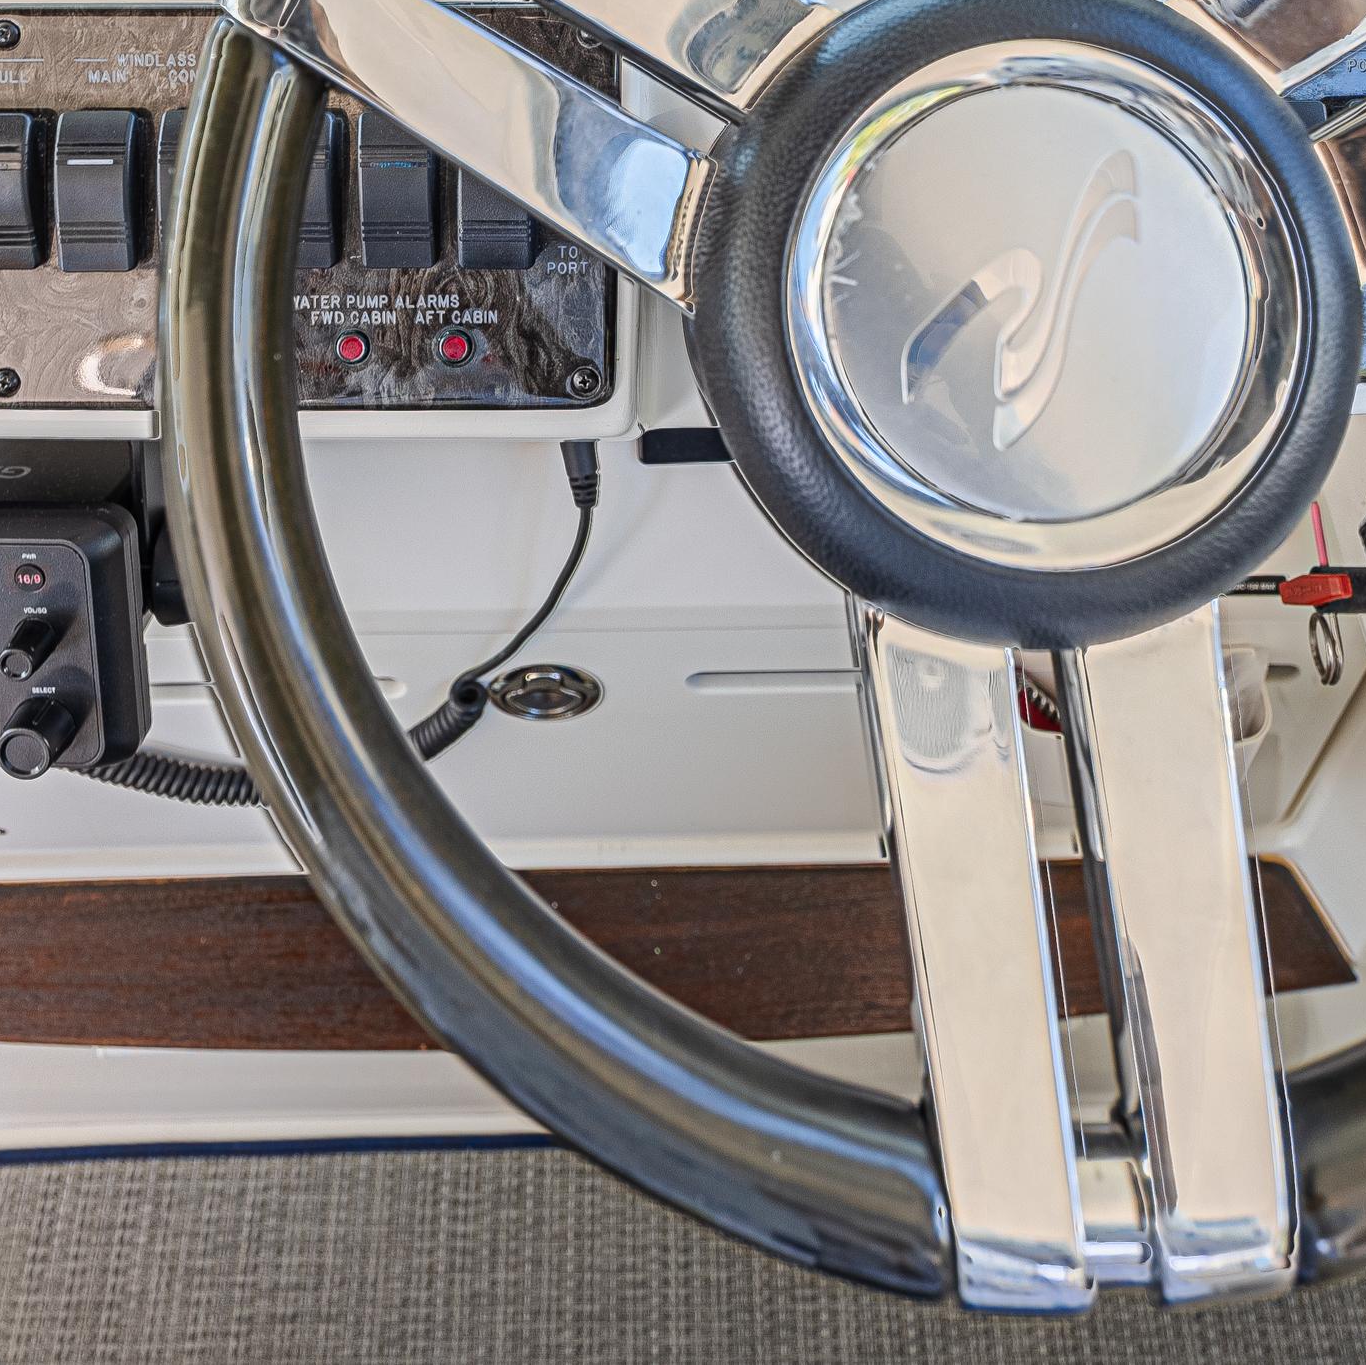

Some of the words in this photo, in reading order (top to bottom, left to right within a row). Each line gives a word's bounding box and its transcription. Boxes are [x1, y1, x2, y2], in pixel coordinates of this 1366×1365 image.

[117, 53, 197, 67] WINDLASS
[88, 70, 127, 84] MAIN
[557, 245, 578, 259] TO
[547, 262, 589, 275] PORT
[346, 295, 388, 309] PUMP
[395, 294, 460, 309] ALARMS
[311, 311, 345, 325] FWD
[350, 310, 396, 325] CABIN
[415, 310, 445, 324] AFT
[451, 310, 498, 324] CABIN
[18, 574, 41, 584] 16/9
